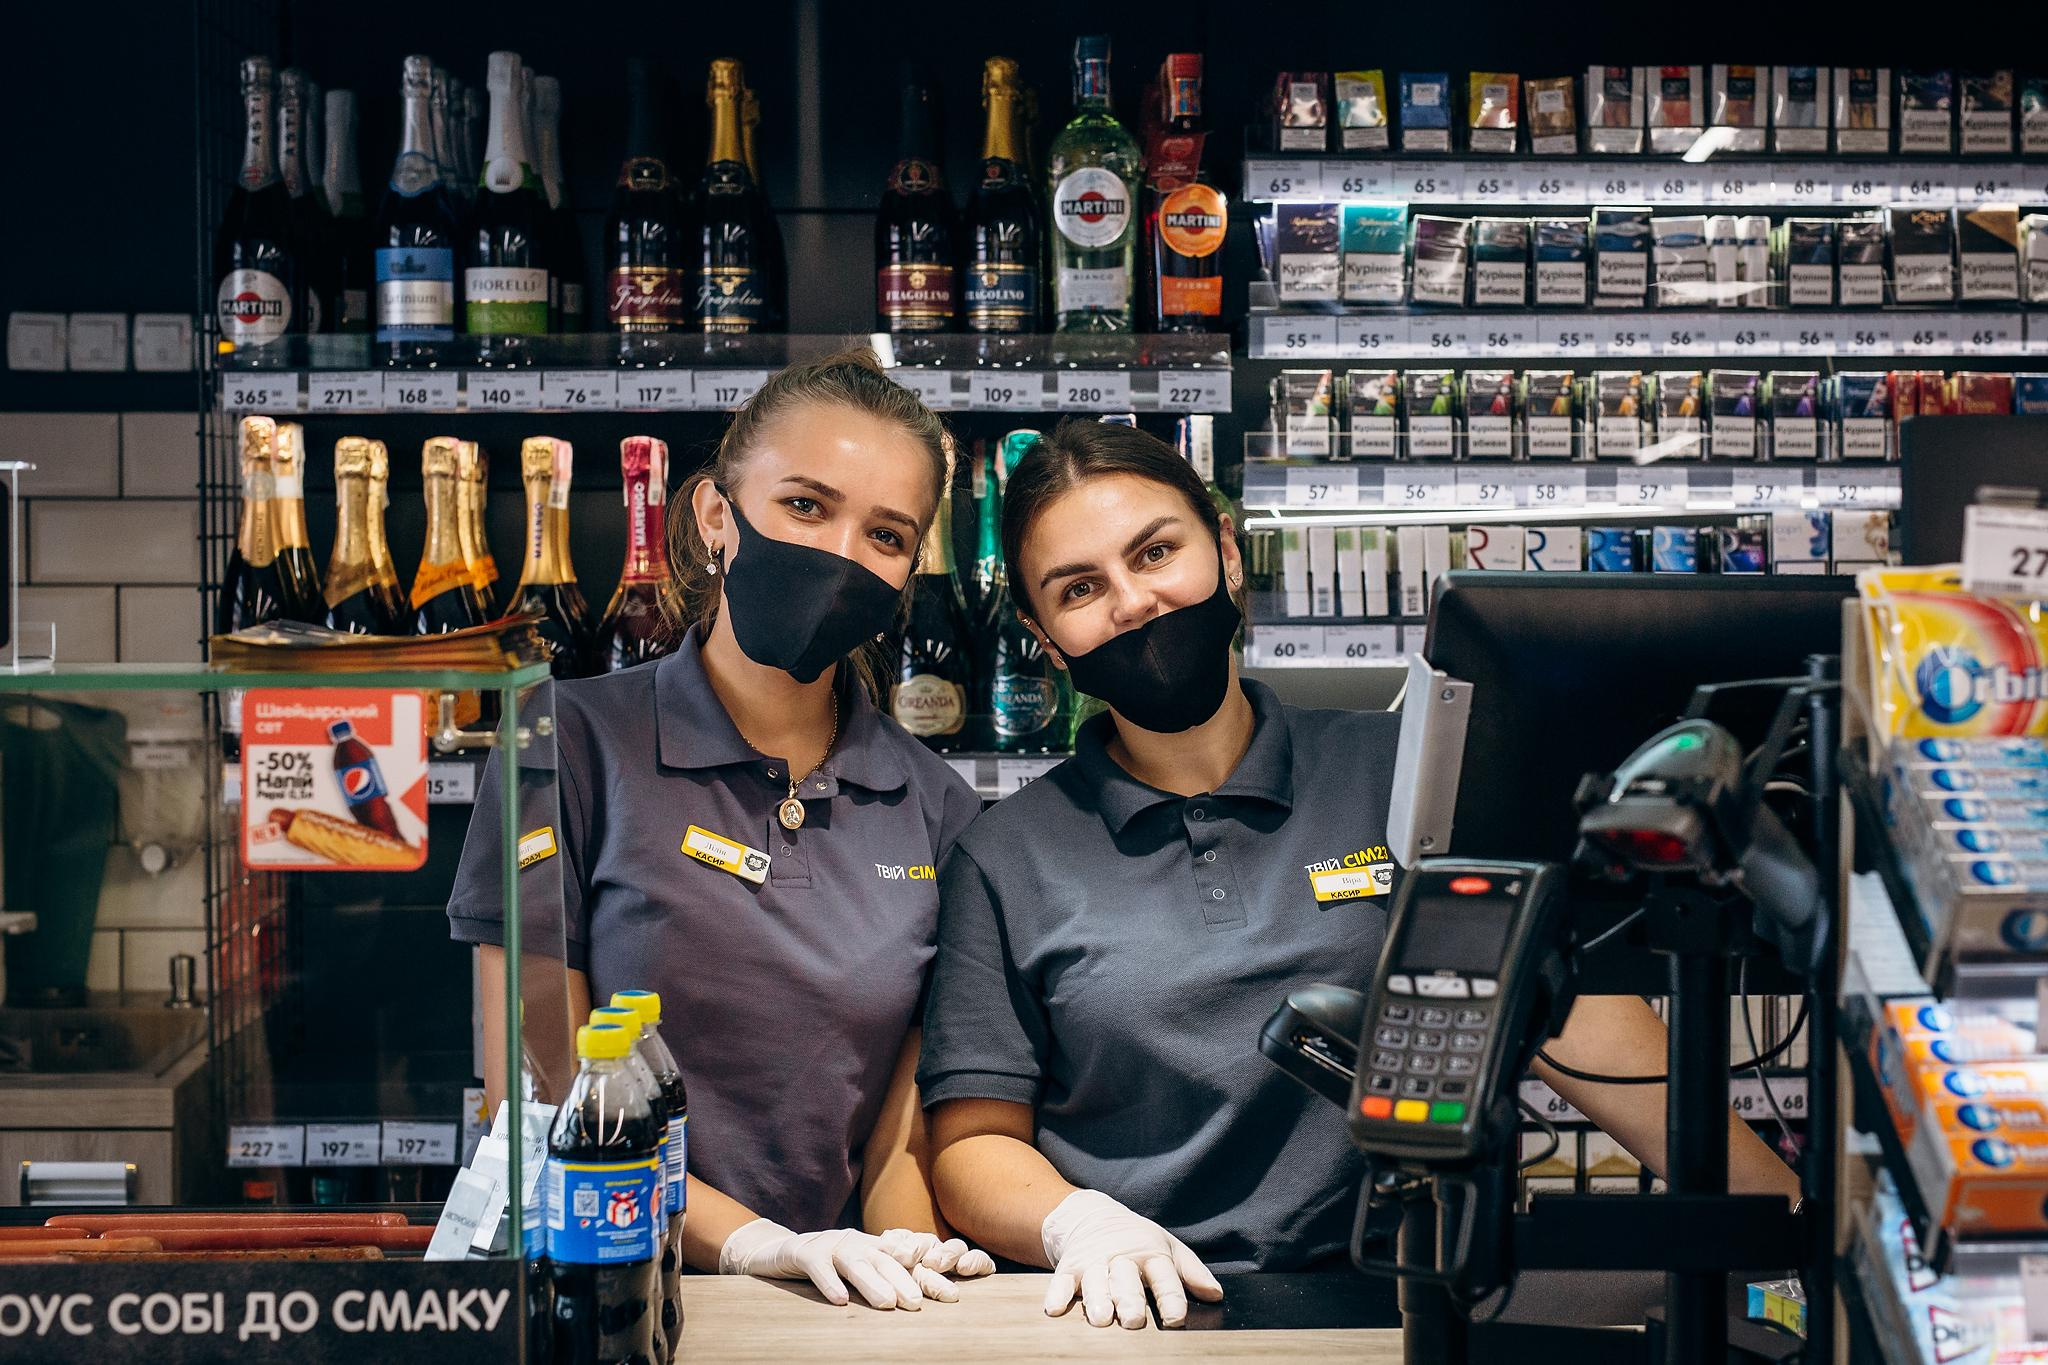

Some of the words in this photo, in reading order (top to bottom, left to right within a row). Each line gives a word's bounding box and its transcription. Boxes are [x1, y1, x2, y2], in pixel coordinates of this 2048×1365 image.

[1269, 178, 1291, 193] 65
[1342, 178, 1364, 193] 65
[1414, 178, 1436, 193] 65
[1477, 179, 1499, 194] 65
[1539, 179, 1561, 194] 65
[1605, 179, 1626, 194] 68
[1663, 179, 1684, 194] 68
[1722, 179, 1743, 194] 68
[1794, 179, 1814, 194] 68
[1851, 180, 1872, 195] 68
[1062, 200, 1124, 214] MARTINI
[1166, 214, 1221, 227] MARTINI
[471, 278, 537, 292] FIORELLI
[222, 300, 281, 315] MARTINI
[1285, 333, 1307, 349] 55
[1359, 333, 1381, 349] 55
[1431, 333, 1452, 348] 56
[1487, 332, 1509, 347] 56
[1559, 332, 1580, 347] 55
[1614, 331, 1636, 347] 55
[1670, 331, 1692, 346] 56
[1735, 331, 1757, 346] 63
[1799, 331, 1821, 346] 56
[1855, 331, 1876, 346] 56
[1913, 330, 1934, 345] 65
[1972, 330, 1994, 345] 65
[234, 389, 267, 405] 365
[324, 389, 353, 404] 271
[399, 389, 428, 404] 168
[482, 389, 511, 404] 140
[565, 389, 587, 403] 76
[637, 387, 662, 402] 117
[714, 387, 738, 402] 117
[983, 387, 1013, 403] 109
[1068, 388, 1101, 403] 280
[1169, 388, 1202, 403] 227
[1308, 484, 1328, 500] 57
[1405, 484, 1426, 500] 56
[1479, 484, 1499, 500] 57
[1535, 484, 1556, 500] 58
[1639, 484, 1659, 500] 57
[1754, 484, 1774, 501] 57
[1837, 484, 1858, 501] 52
[633, 481, 647, 547] MARENGO
[1273, 642, 1296, 658] 60
[1345, 643, 1368, 658] 60
[257, 752, 314, 771] -50%
[256, 770, 313, 789] Напій
[695, 850, 725, 866] КАСИР
[1303, 857, 1342, 873] ТВІЙ
[874, 863, 906, 880] ТВІЙ
[1330, 889, 1361, 899] КАСИР
[1547, 1097, 1569, 1113] 68
[1732, 1096, 1753, 1111] 68
[1782, 1095, 1804, 1110] 68
[240, 1141, 273, 1158] 227
[321, 1141, 350, 1158] 197
[397, 1138, 427, 1155] 197
[107, 1291, 224, 1336] СОБІ
[238, 1289, 320, 1342] ДО
[332, 1287, 511, 1333] СМАКУ
